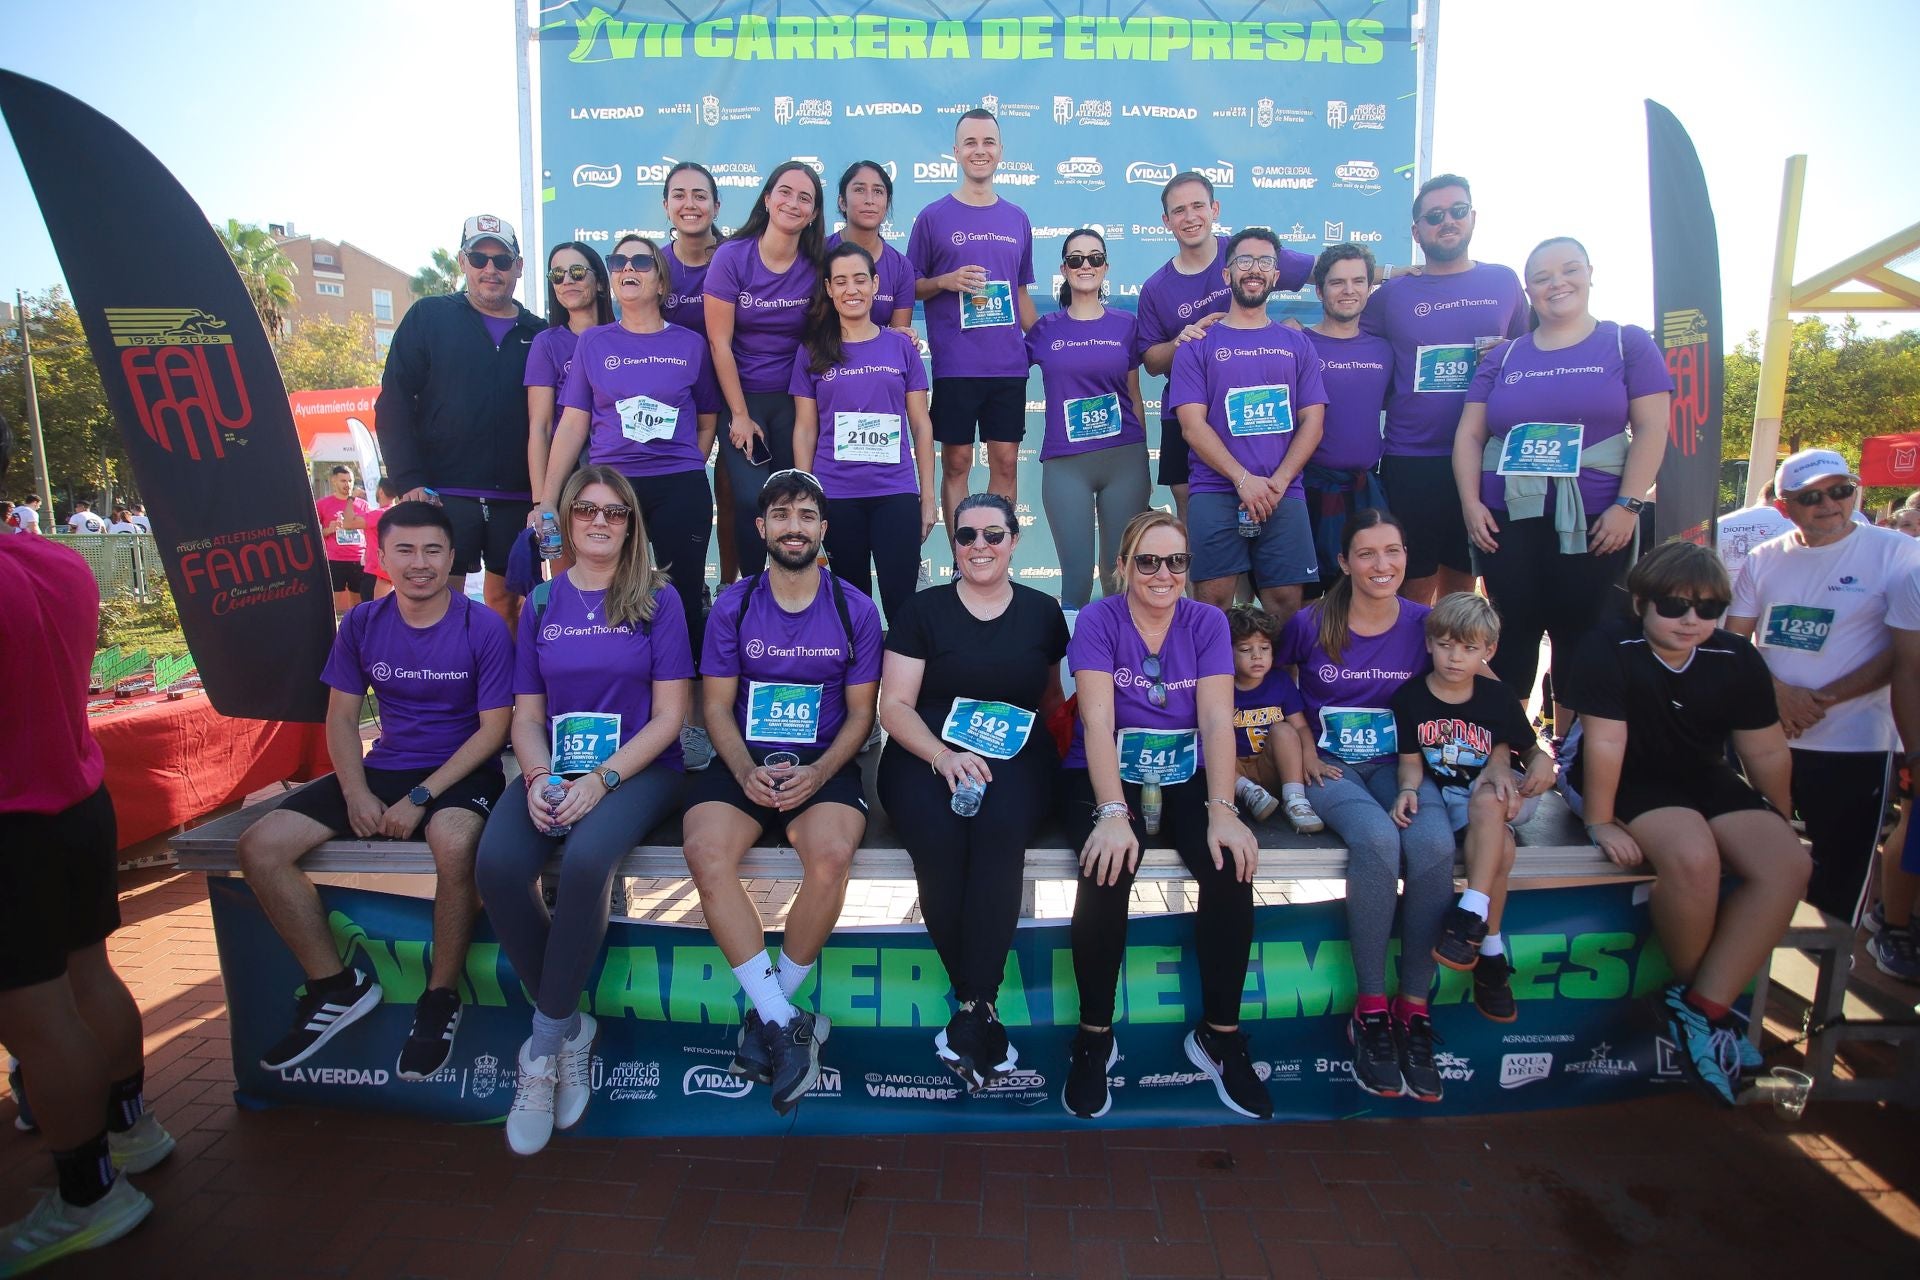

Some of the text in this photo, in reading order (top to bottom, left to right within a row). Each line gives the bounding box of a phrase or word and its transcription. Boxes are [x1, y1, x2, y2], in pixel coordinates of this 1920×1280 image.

[606, 14, 1385, 64] VII CARRERA DE EMPRESAS
[570, 106, 644, 120] LA VERDAD
[721, 106, 760, 114] Ayuntamiento
[846, 103, 922, 116] LA VERDAD
[1000, 103, 1040, 112] Ayuntamiento
[1122, 106, 1198, 120] LA VERDAD
[730, 164, 757, 172] GLOBAL
[914, 163, 958, 178] DSM
[1006, 162, 1034, 171] GLOBAL
[1134, 168, 1170, 178] VIDAL
[1266, 167, 1312, 175] AMC GLOBAL
[580, 172, 615, 182] VIDAL
[574, 228, 608, 242] itres
[1032, 226, 1075, 238] talayas
[1351, 231, 1382, 242] Hero
[1120, 284, 1139, 296] LA
[128, 335, 220, 345] 1925 2025
[1434, 361, 1468, 376] 539
[295, 400, 368, 416] Ayuntamiento de
[1244, 403, 1274, 418] 547
[1082, 409, 1108, 424] 538
[848, 431, 888, 445] 2108
[1520, 440, 1561, 455] 552
[1724, 525, 1756, 534] bionet
[177, 541, 212, 552] murcia
[213, 528, 274, 546] ATLETISMO
[180, 534, 314, 594] FAMU
[1780, 617, 1829, 636] 1230
[770, 702, 810, 720] 546
[1234, 706, 1284, 728] AKERS
[970, 711, 1010, 738] 542
[564, 734, 598, 751] 557
[1340, 728, 1378, 744] 543
[1418, 719, 1492, 755] JORDAN
[1139, 749, 1176, 766] 541
[683, 1046, 736, 1056] PATROCINAN
[1508, 1056, 1548, 1066] AQUA
[1564, 1059, 1638, 1072] ESTRELLA
[281, 1068, 389, 1086] LA VERDAD
[612, 1064, 660, 1078] murcia
[1508, 1066, 1544, 1076] DEUS
[499, 1080, 509, 1088] de
[605, 1078, 660, 1086] ATLETISMO
[694, 1074, 745, 1088] VIDAL
[885, 1074, 954, 1086] AMC GLOBAL
[610, 1089, 658, 1100] Corriendo
[1022, 1092, 1048, 1100] familia
